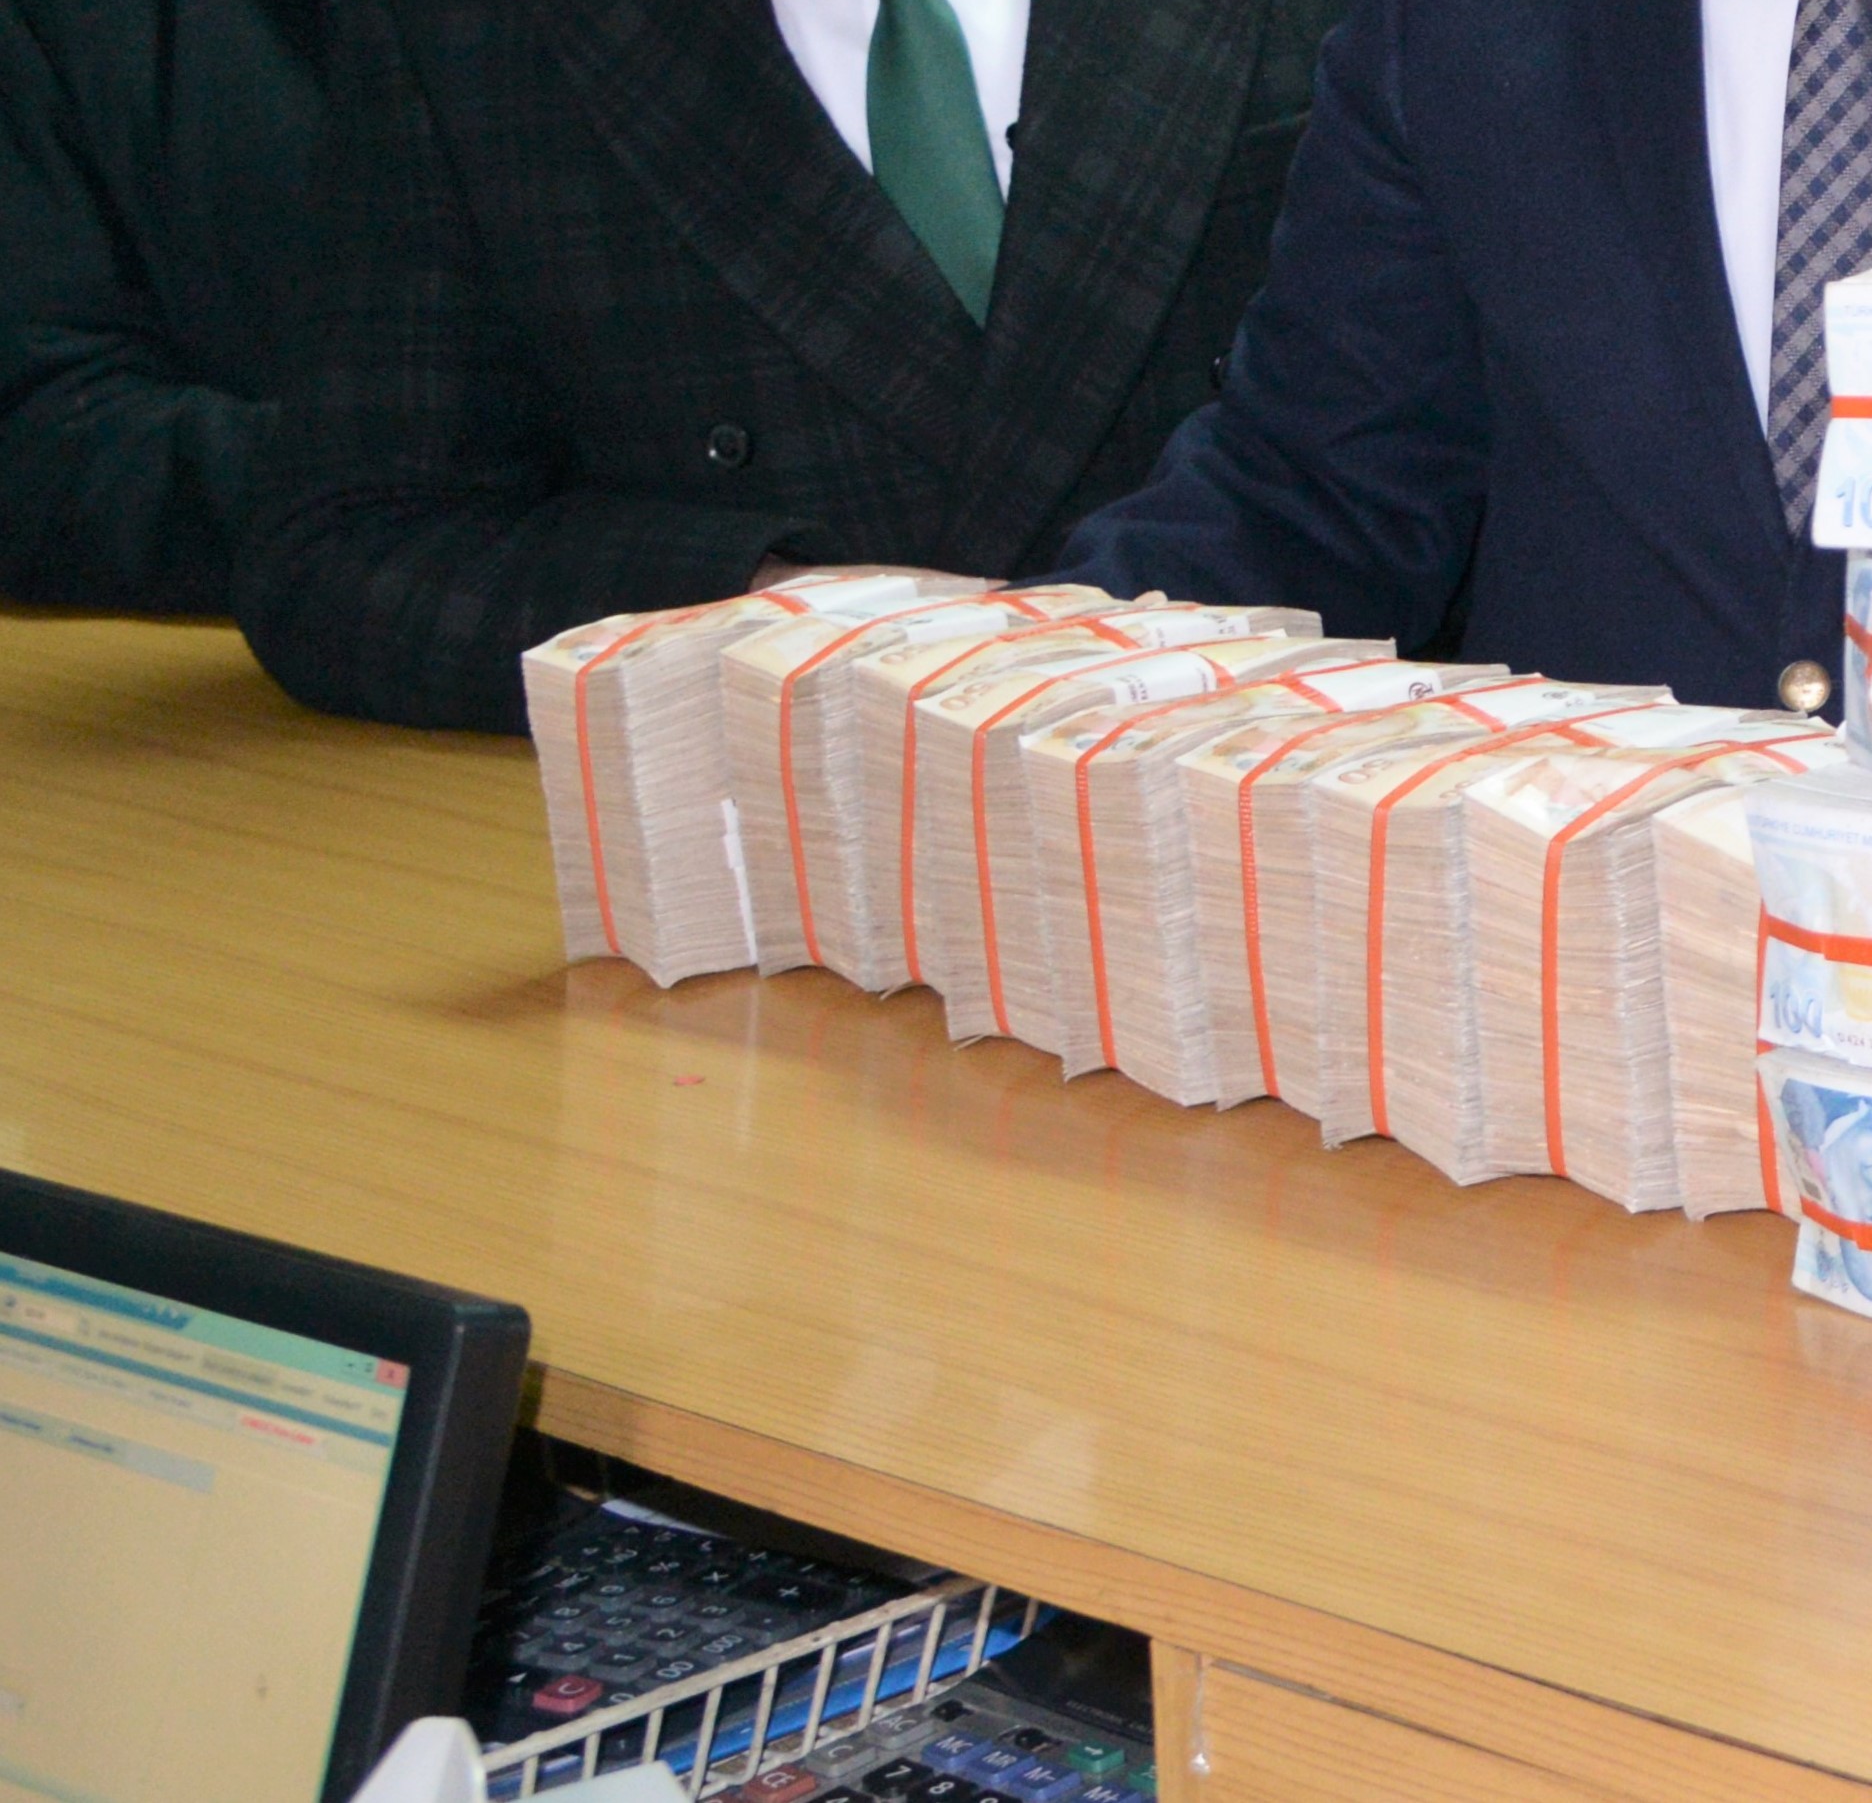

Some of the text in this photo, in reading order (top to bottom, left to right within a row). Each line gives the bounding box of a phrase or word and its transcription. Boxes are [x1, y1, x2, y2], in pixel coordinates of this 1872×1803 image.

[1769, 979, 1824, 1040] 100
[885, 1715, 918, 1731] AC
[828, 1745, 854, 1758] C
[937, 1736, 974, 1754] MC
[982, 1750, 1017, 1768] MR
[885, 1765, 912, 1778] 7
[762, 1772, 797, 1789] CE
[929, 1782, 955, 1795] 8
